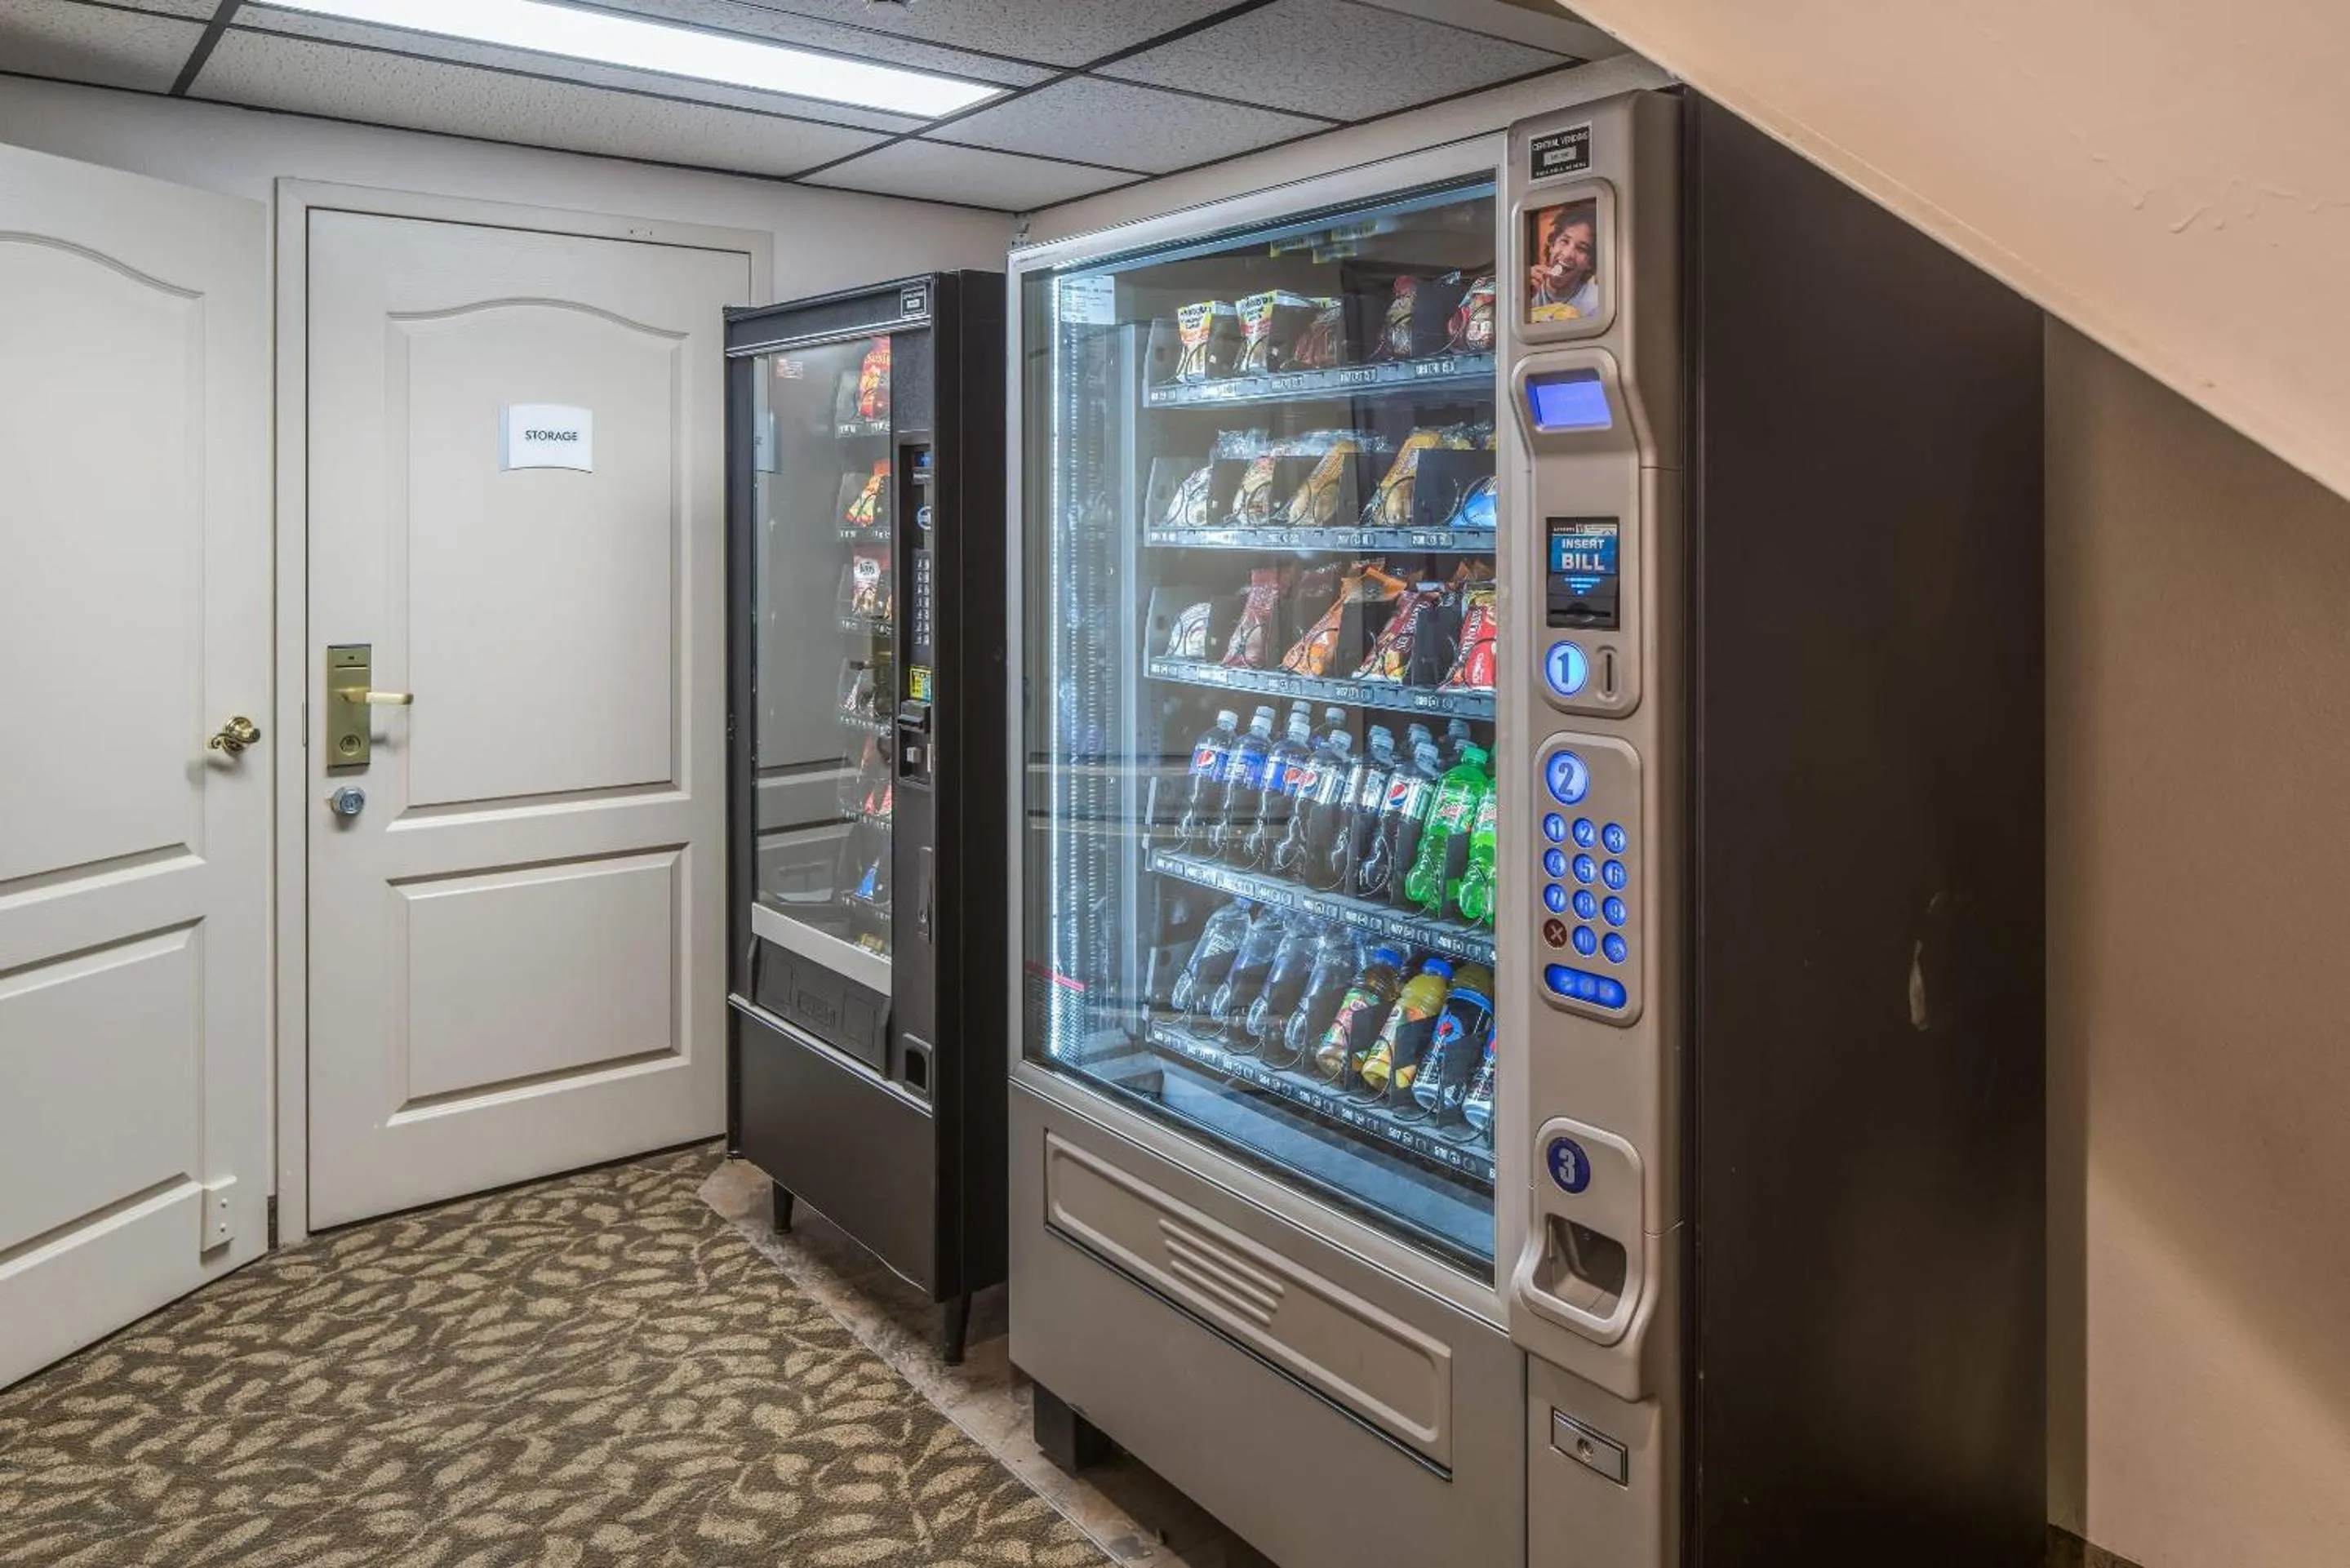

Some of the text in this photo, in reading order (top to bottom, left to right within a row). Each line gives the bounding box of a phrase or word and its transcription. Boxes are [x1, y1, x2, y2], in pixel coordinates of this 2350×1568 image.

[525, 430, 579, 442] STORAGE
[1561, 539, 1606, 549] INSERT
[1561, 553, 1606, 571] BILL
[1557, 651, 1570, 684] 1
[1557, 762, 1575, 796] 2
[1557, 1147, 1576, 1184] 3
